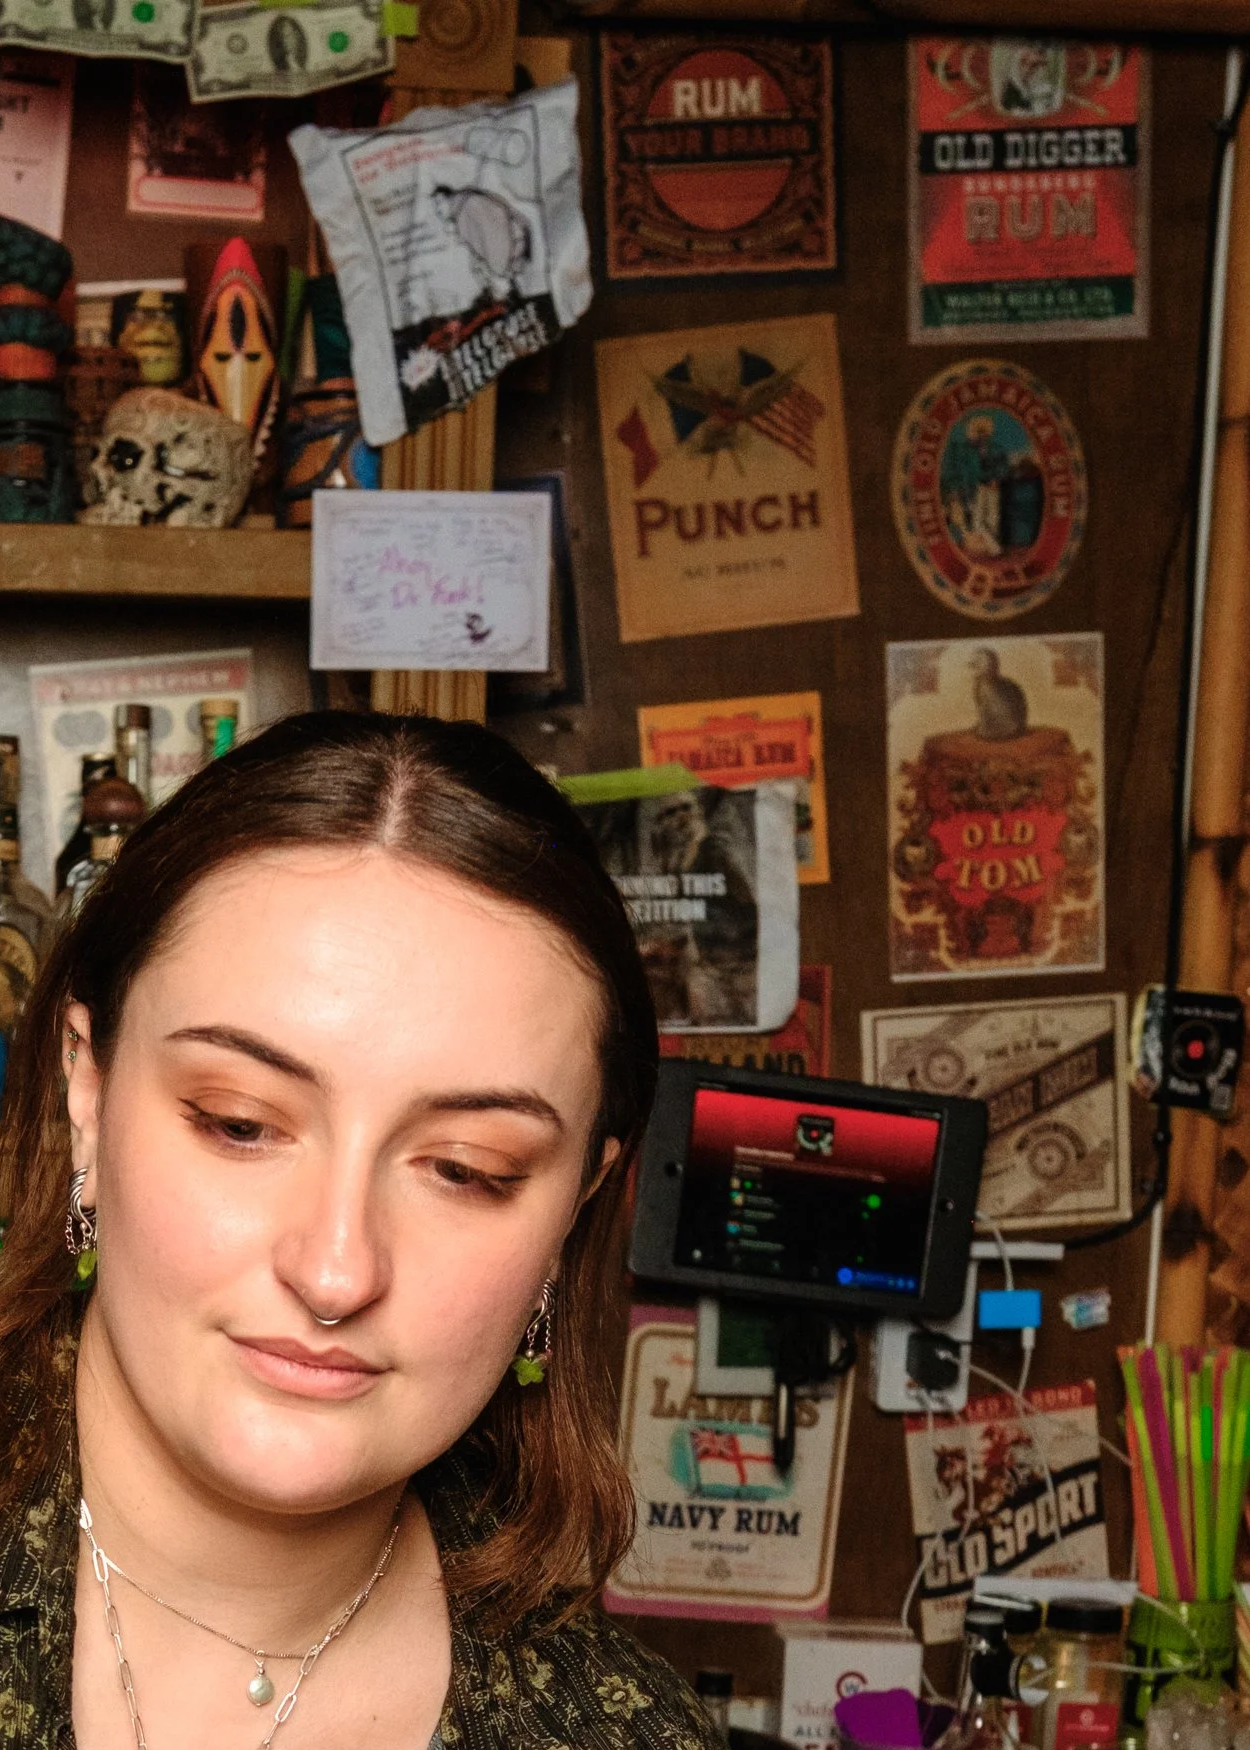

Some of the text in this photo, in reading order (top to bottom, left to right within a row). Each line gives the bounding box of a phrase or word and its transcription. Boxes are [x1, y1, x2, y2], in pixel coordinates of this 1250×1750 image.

[672, 76, 762, 118] RUM
[933, 126, 1128, 172] OLD DIGGER
[964, 192, 1097, 243] RUM
[949, 380, 1055, 440] JAMAICA
[633, 491, 821, 559] PUNCH
[961, 819, 1036, 849] OLD
[681, 872, 727, 897] THIS
[955, 852, 1044, 891] TOM
[647, 1502, 803, 1538] NAVY RUM
[921, 1472, 1100, 1589] OLD SPORT
